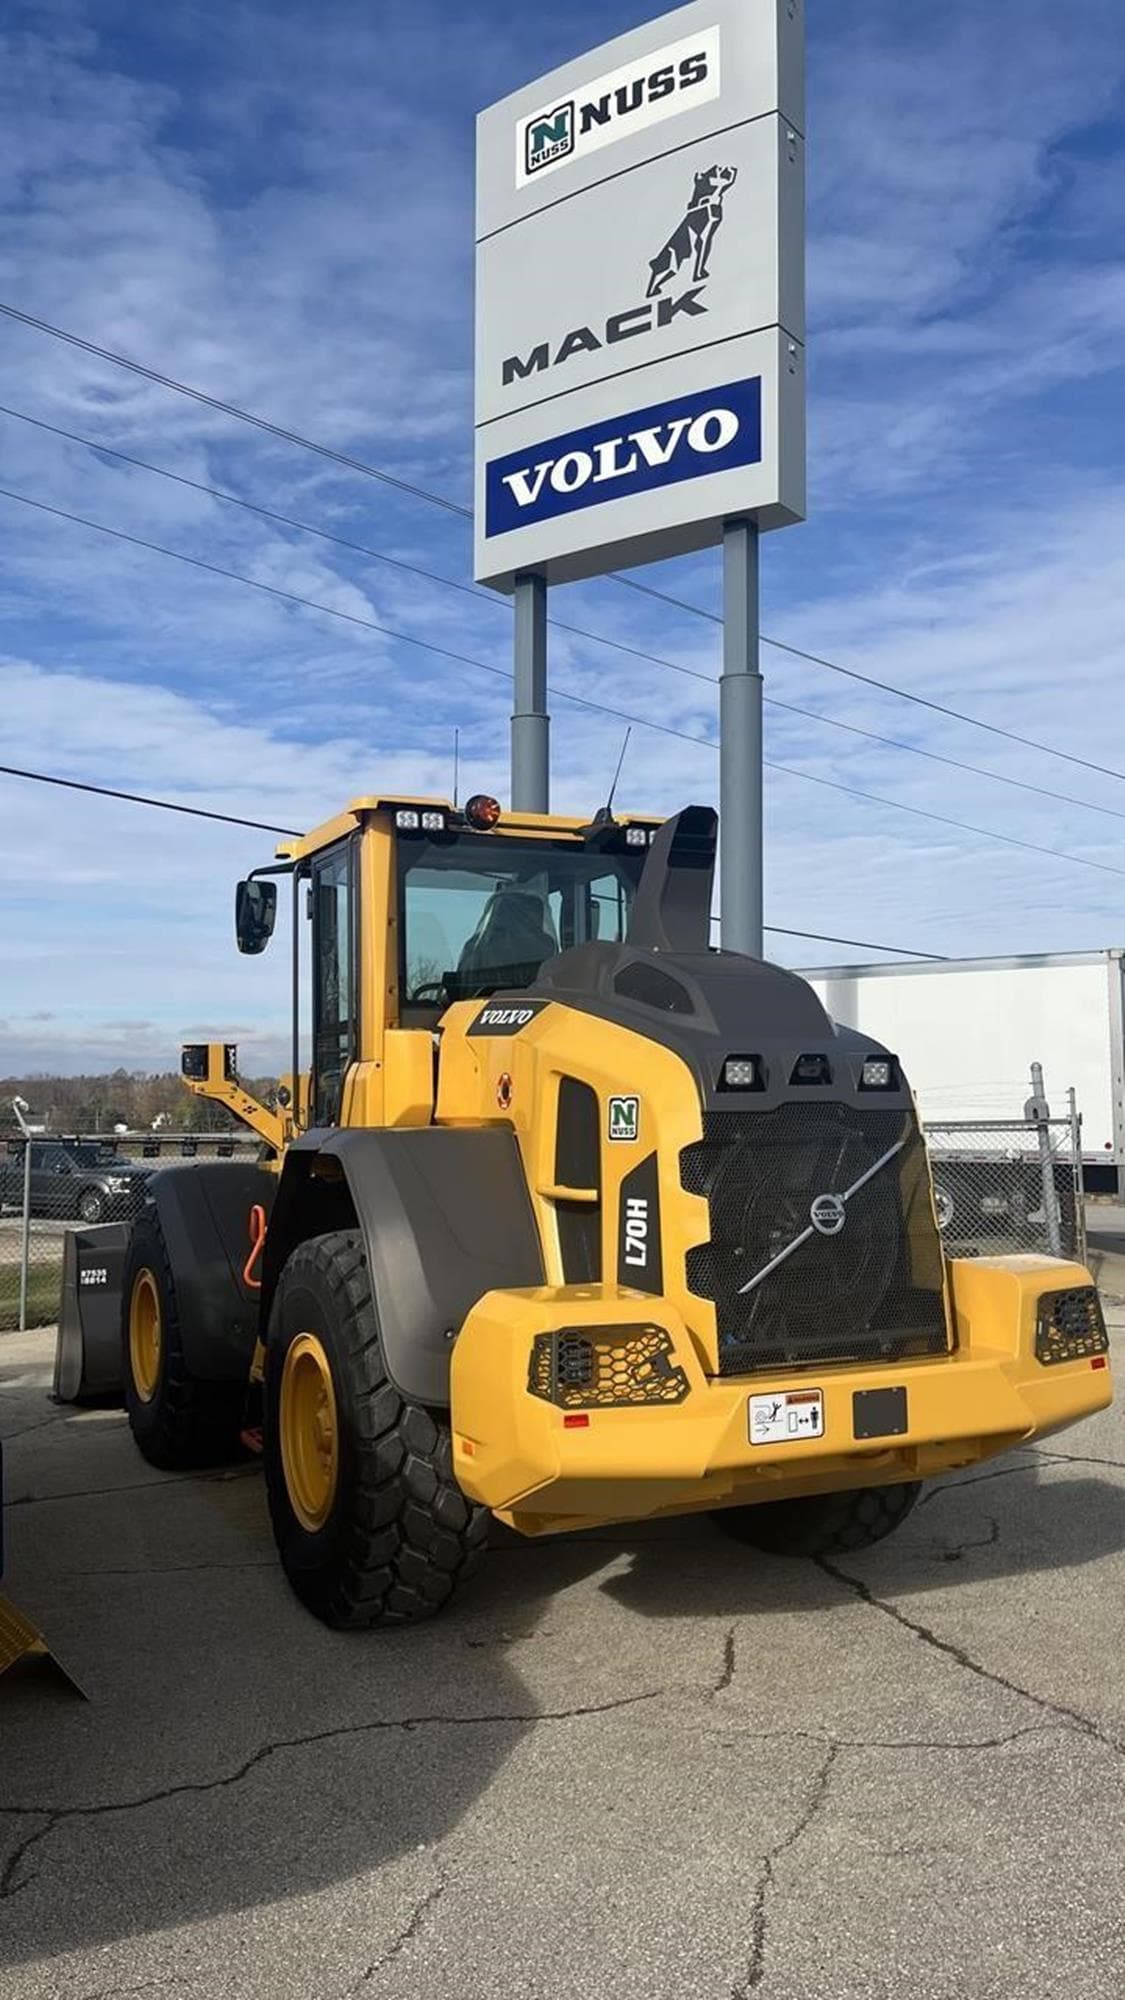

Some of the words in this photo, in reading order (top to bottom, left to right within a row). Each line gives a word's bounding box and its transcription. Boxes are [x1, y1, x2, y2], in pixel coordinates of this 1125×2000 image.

[579, 52, 707, 134] NUSS
[531, 110, 569, 155] N
[531, 138, 569, 167] NUSS
[502, 284, 709, 386] MACK
[502, 408, 739, 507] VOLVO
[480, 1009, 534, 1024] VOLVO
[612, 1103, 635, 1126] N
[612, 1127, 635, 1136] NUSS
[625, 1198, 648, 1267] L70H
